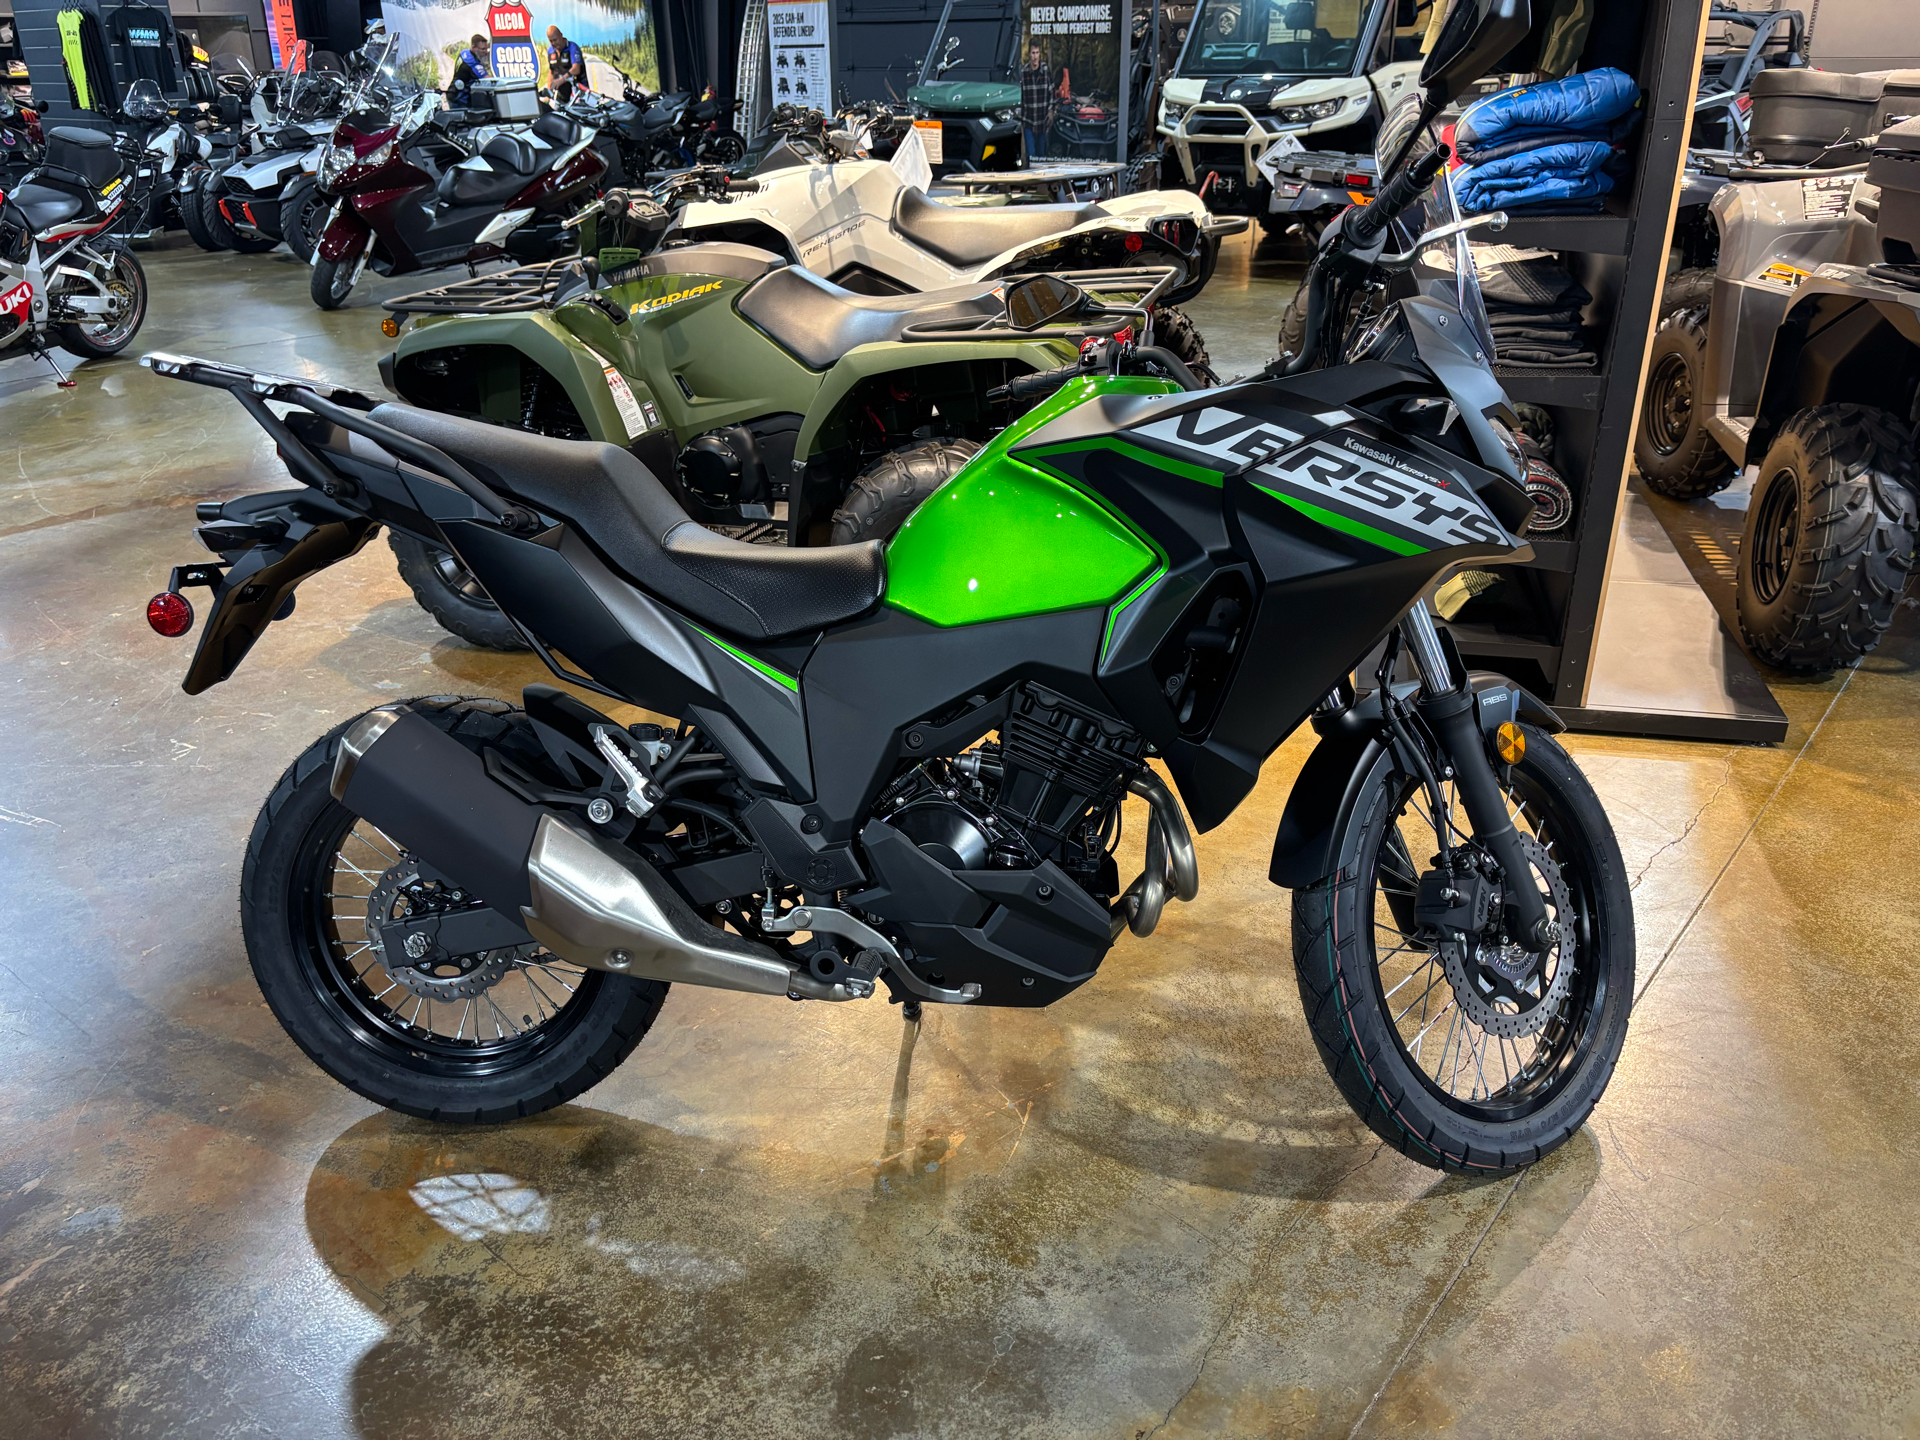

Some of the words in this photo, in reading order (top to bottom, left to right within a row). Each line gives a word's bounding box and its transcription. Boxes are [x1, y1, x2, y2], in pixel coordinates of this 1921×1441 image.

[494, 12, 525, 30] ALCOA
[772, 12, 785, 25] 2025
[785, 11, 805, 24] CAN-AM
[1030, 6, 1056, 22] NEVER
[1057, 4, 1113, 21] COMPROMISE.
[280, 14, 297, 52] LIKE
[773, 26, 797, 38] DEFENDER
[797, 25, 815, 38] LINEUP
[1030, 23, 1052, 35] CREATE
[1052, 22, 1068, 35] YOUR
[1069, 22, 1095, 34] PERFECT
[1095, 21, 1112, 34] RIDE!
[496, 46, 533, 63] GOOD
[496, 62, 536, 80] TIMES
[803, 219, 866, 258] RENEGADE
[612, 264, 650, 282] YAMAHA
[629, 280, 723, 315] KODIAK
[1344, 437, 1396, 466] Kawasaki
[1396, 461, 1451, 489] VERSYS-X
[1176, 409, 1502, 546] VERSYS
[1483, 693, 1508, 706] ABS
